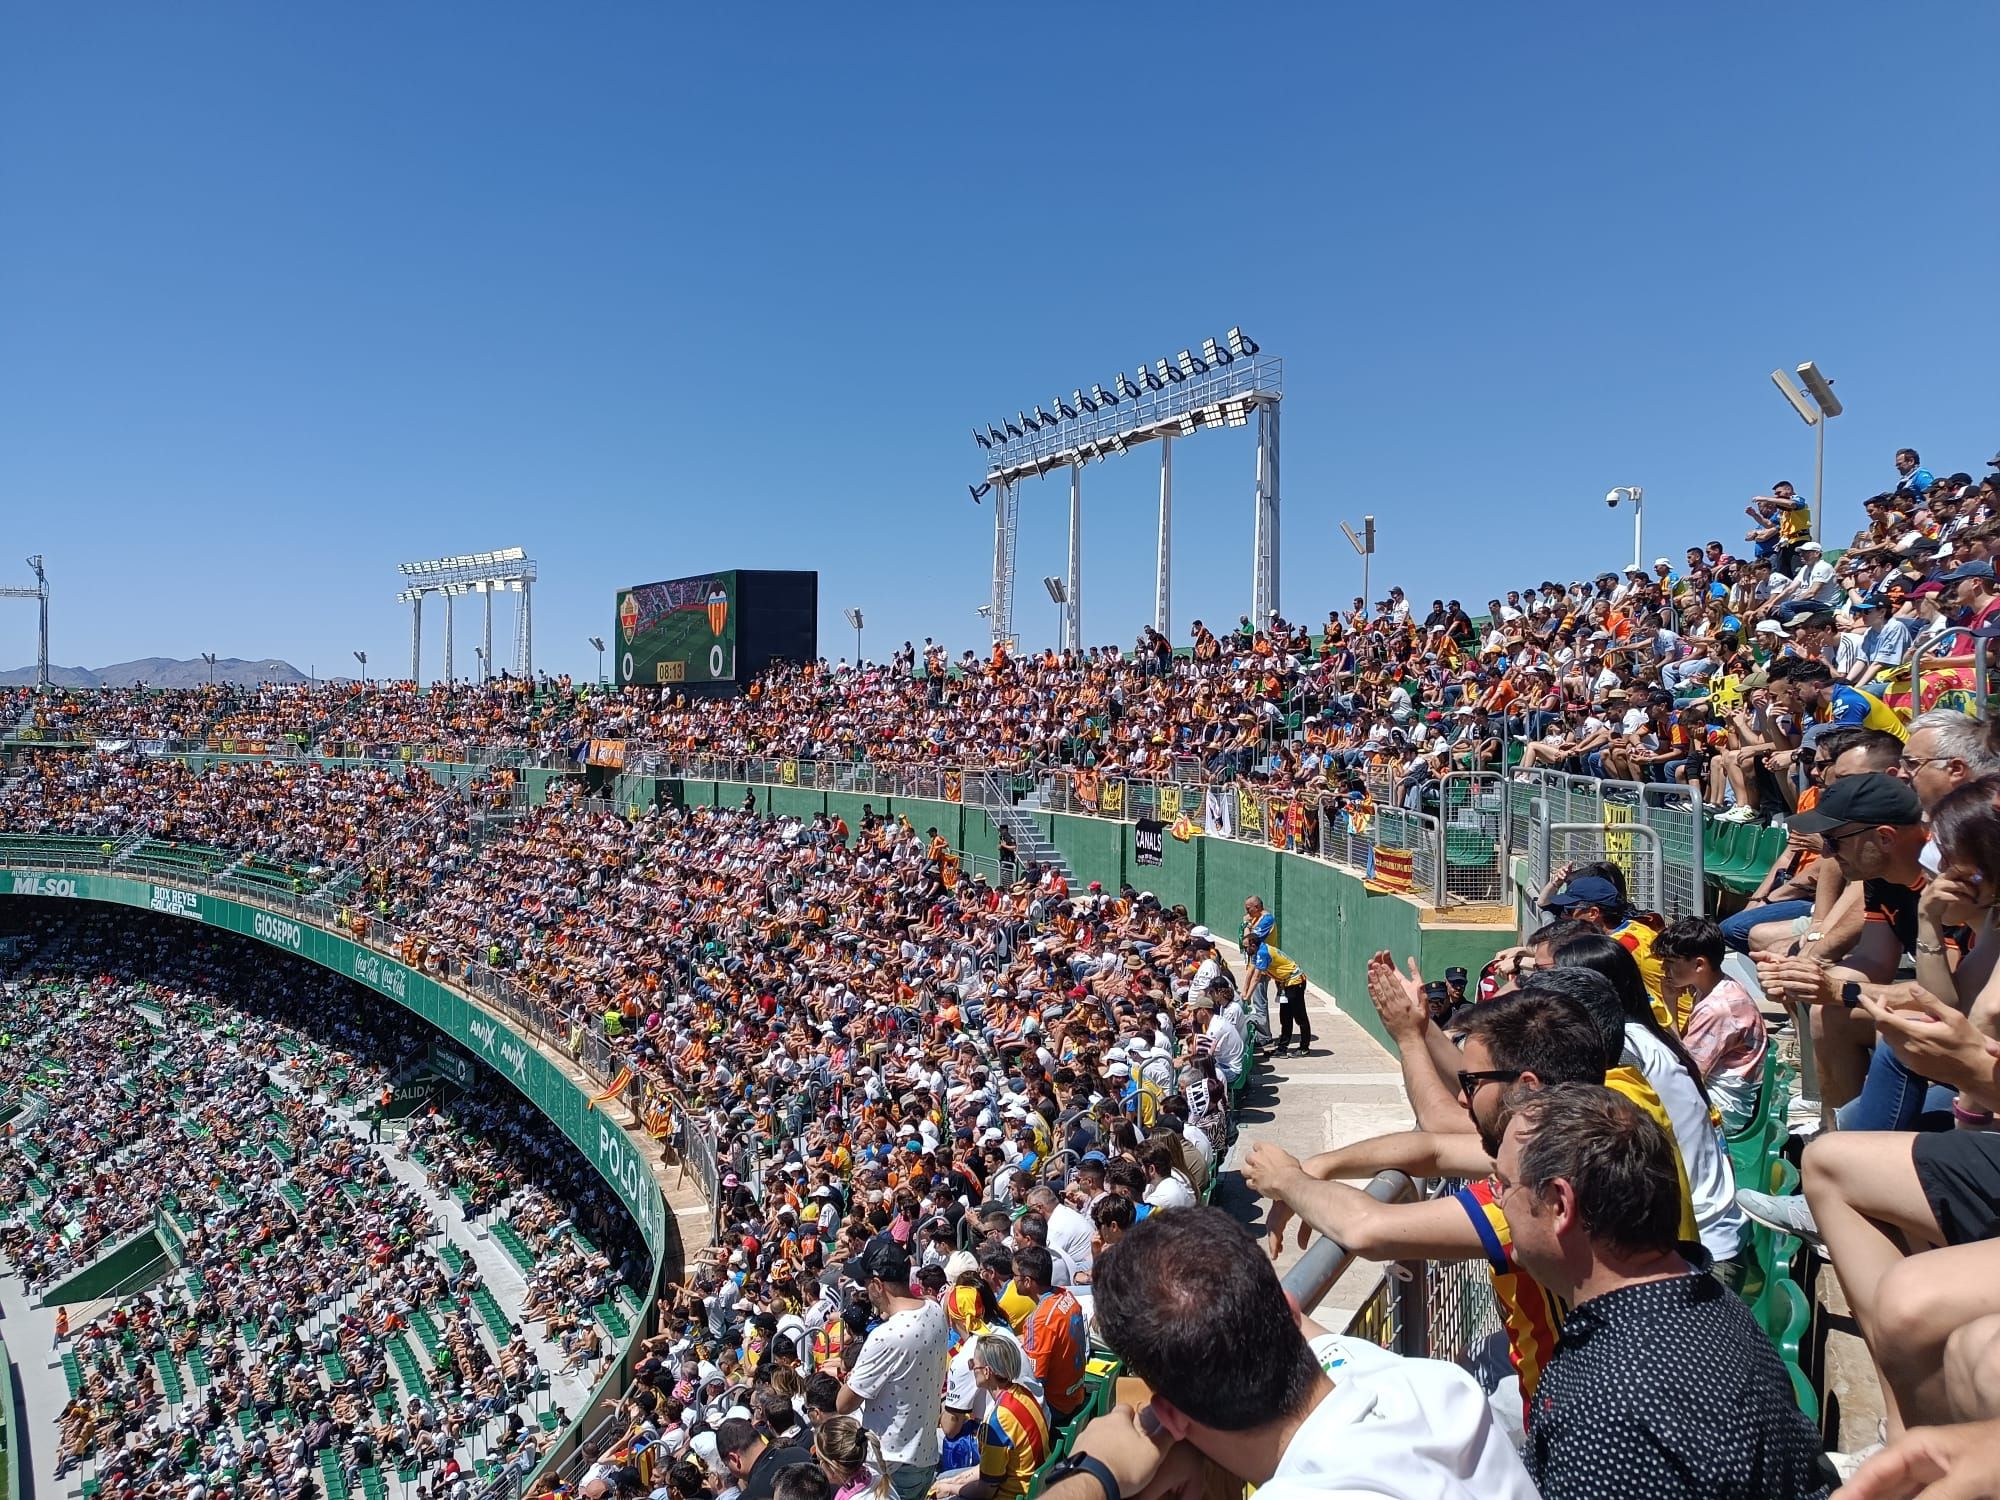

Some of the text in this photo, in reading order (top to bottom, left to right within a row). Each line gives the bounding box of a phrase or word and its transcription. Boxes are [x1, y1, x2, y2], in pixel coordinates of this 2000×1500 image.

[622, 652, 634, 681] 0
[710, 645, 723, 677] 0
[660, 664, 683, 680] 08:13
[1136, 829, 1162, 851] CANALS
[12, 878, 78, 897] MI-SOL
[154, 886, 197, 907] BOX REYES
[255, 912, 301, 949] GIOSEPPO
[394, 1084, 433, 1101] SALIDA
